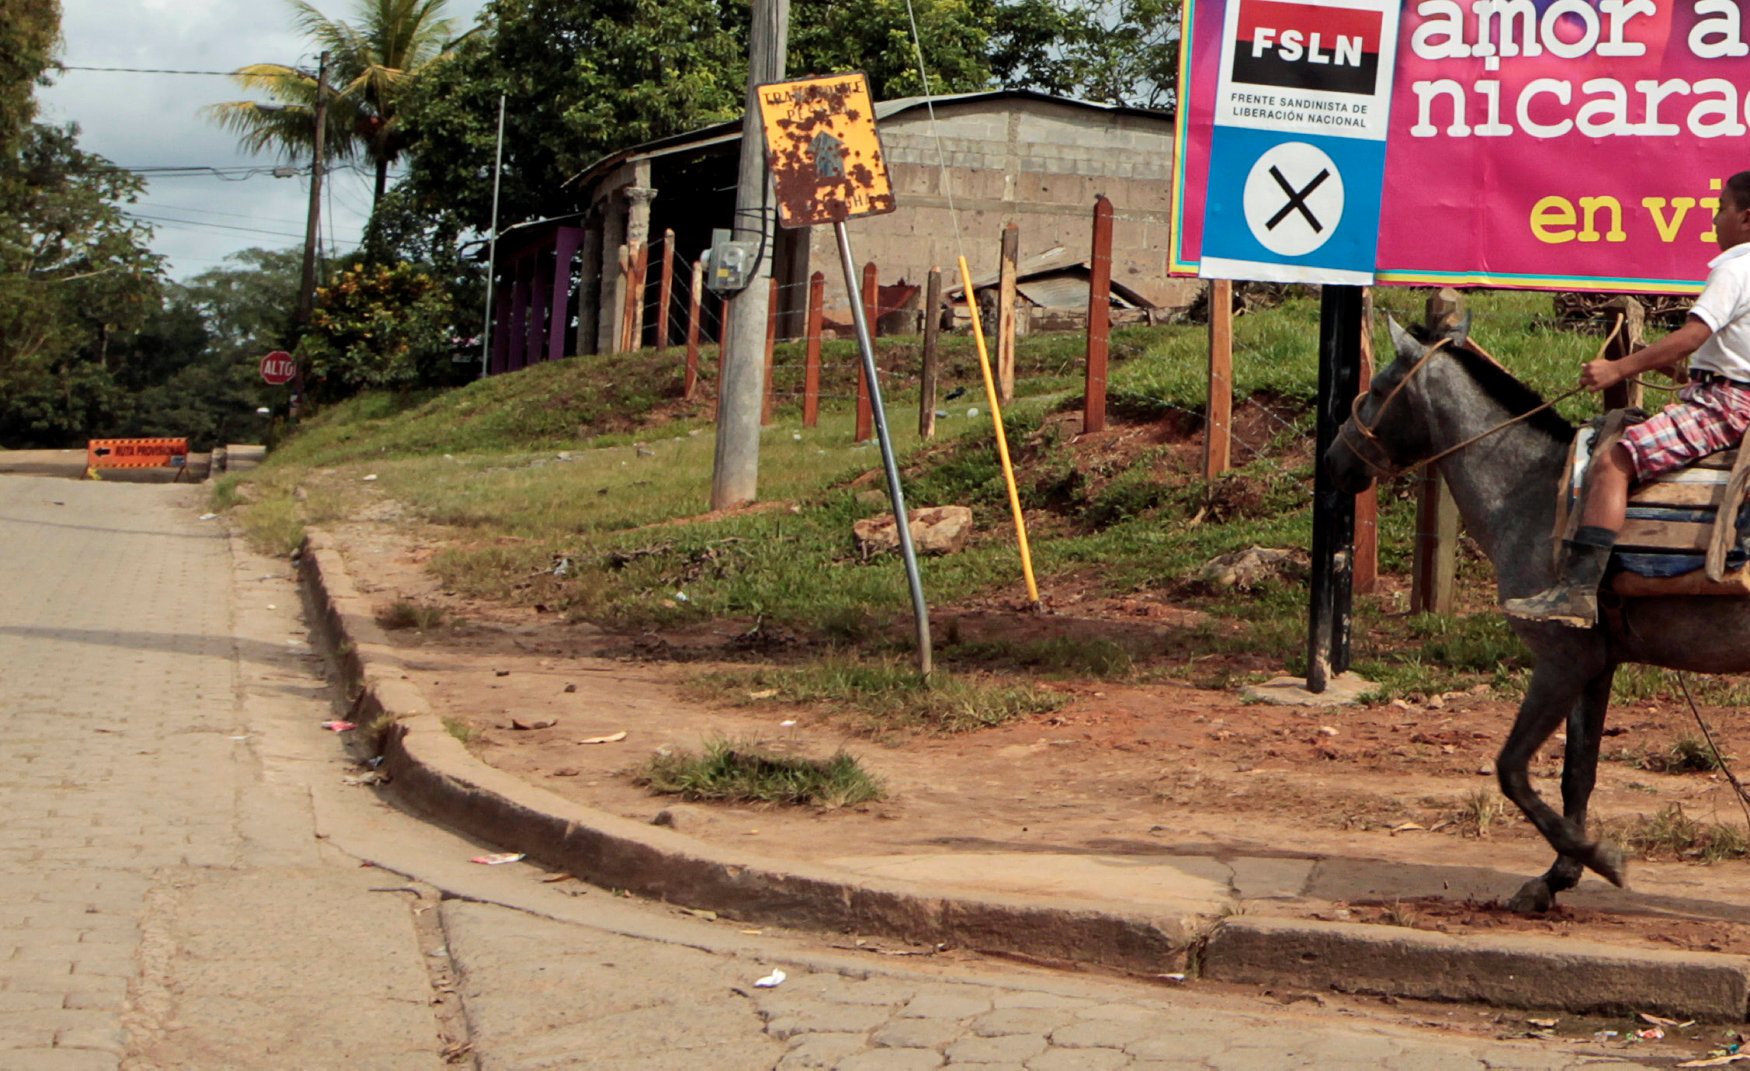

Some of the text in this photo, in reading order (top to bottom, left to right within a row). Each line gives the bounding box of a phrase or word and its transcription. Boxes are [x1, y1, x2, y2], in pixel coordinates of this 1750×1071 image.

[1252, 26, 1363, 68] FSLN
[1231, 93, 1368, 115] FRENTE SANDINISTA DE
[1233, 106, 1367, 128] LIBERACIÓN NACIONAL
[1530, 195, 1627, 244] en
[264, 360, 293, 376] ALTO
